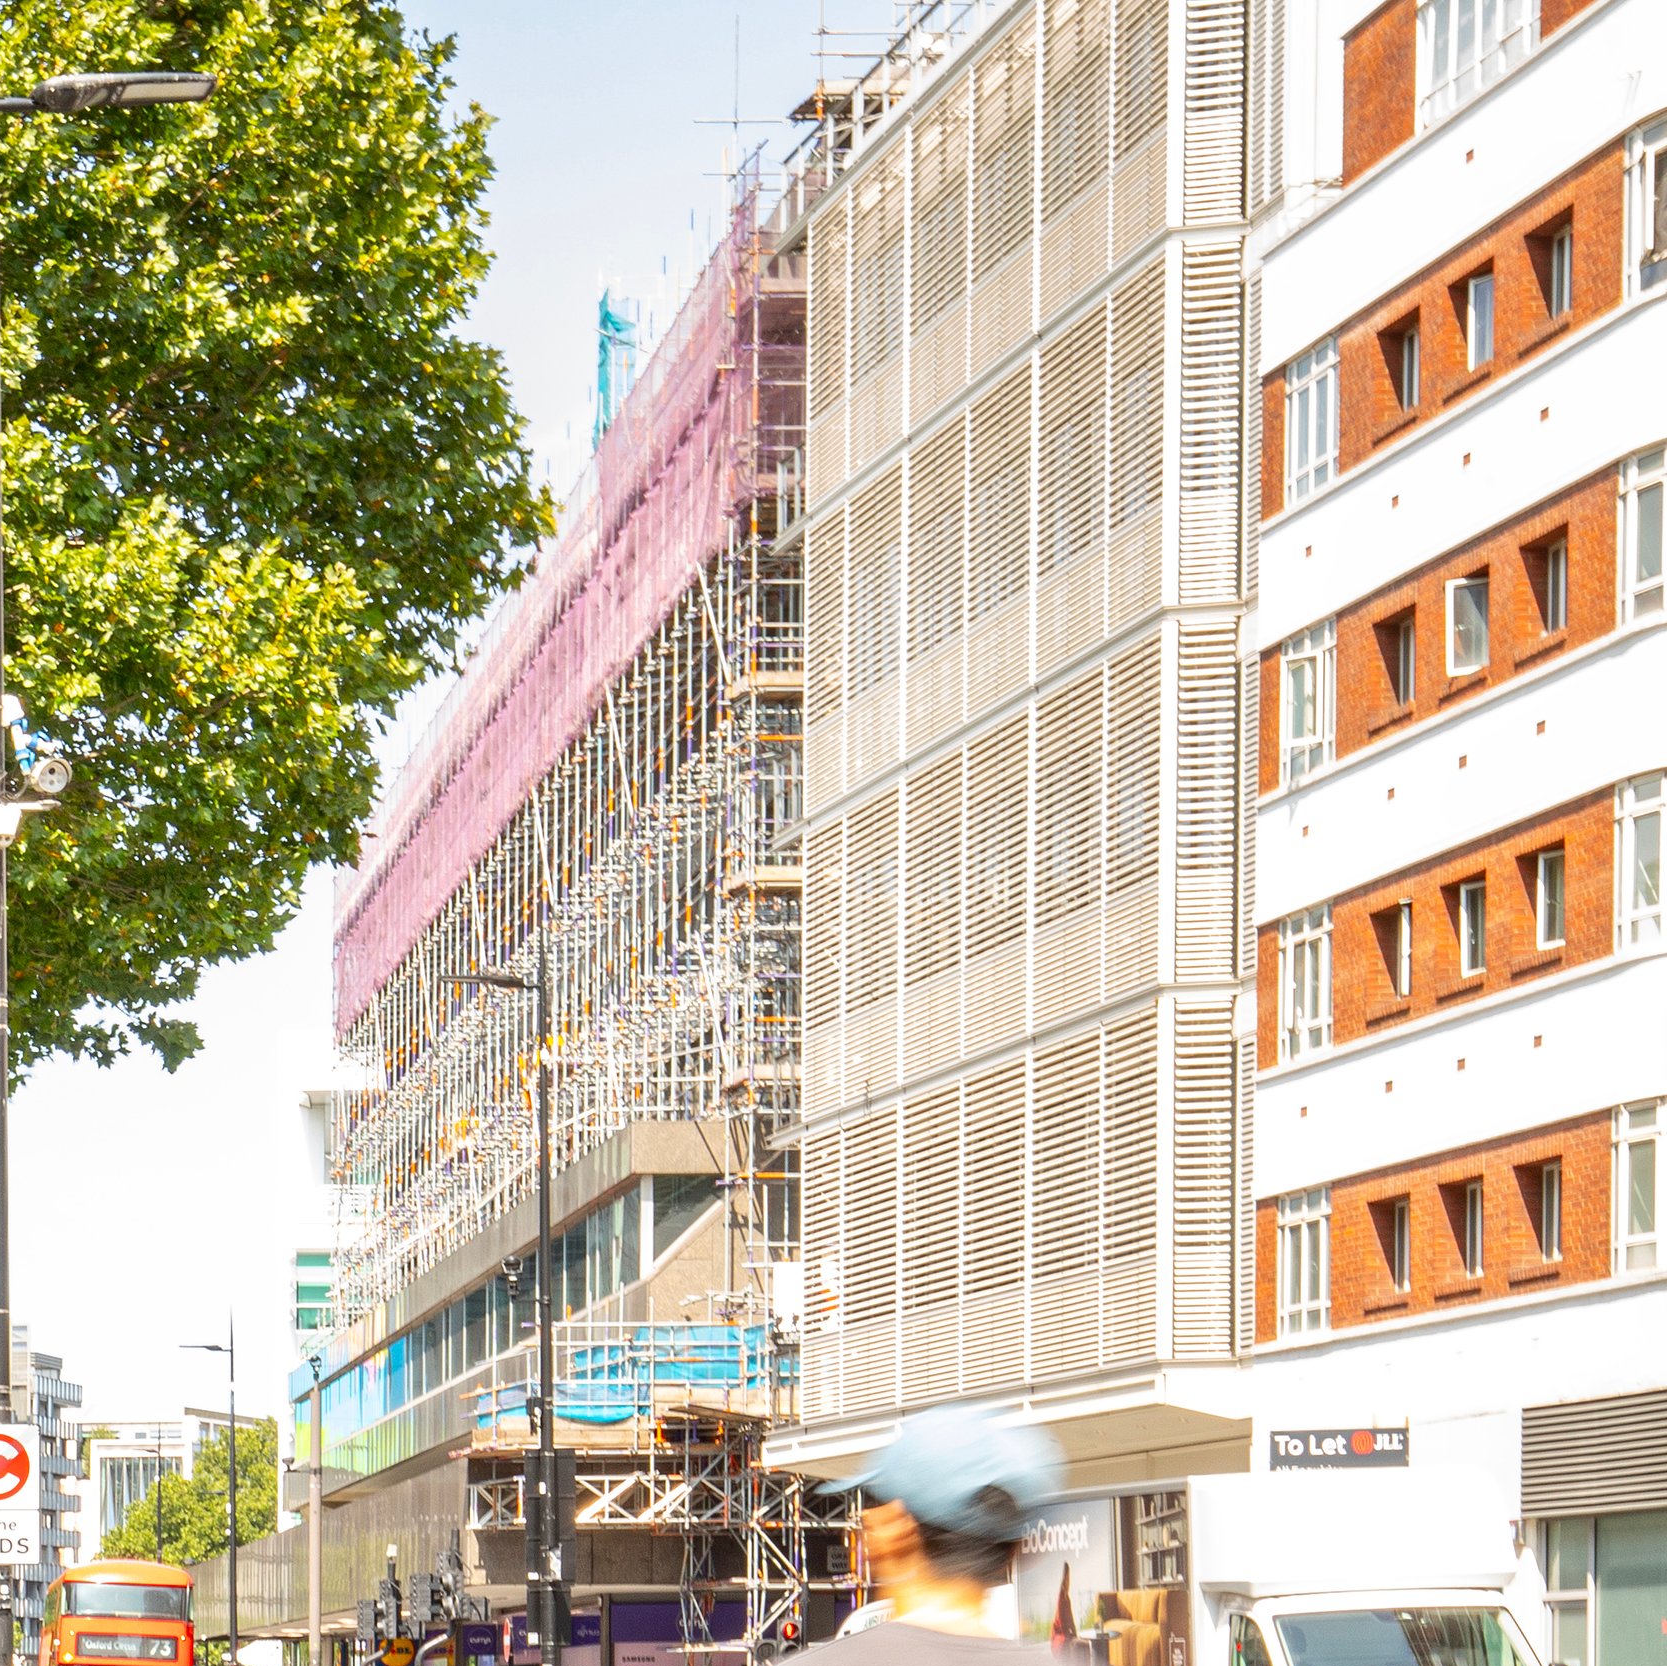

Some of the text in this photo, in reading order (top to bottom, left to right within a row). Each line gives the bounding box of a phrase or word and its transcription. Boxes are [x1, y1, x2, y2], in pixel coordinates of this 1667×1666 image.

[1274, 1433, 1403, 1456] To Let JLL
[1021, 1515, 1089, 1559] BoConcept
[85, 1639, 111, 1651] Oxford
[149, 1638, 173, 1657] 73
